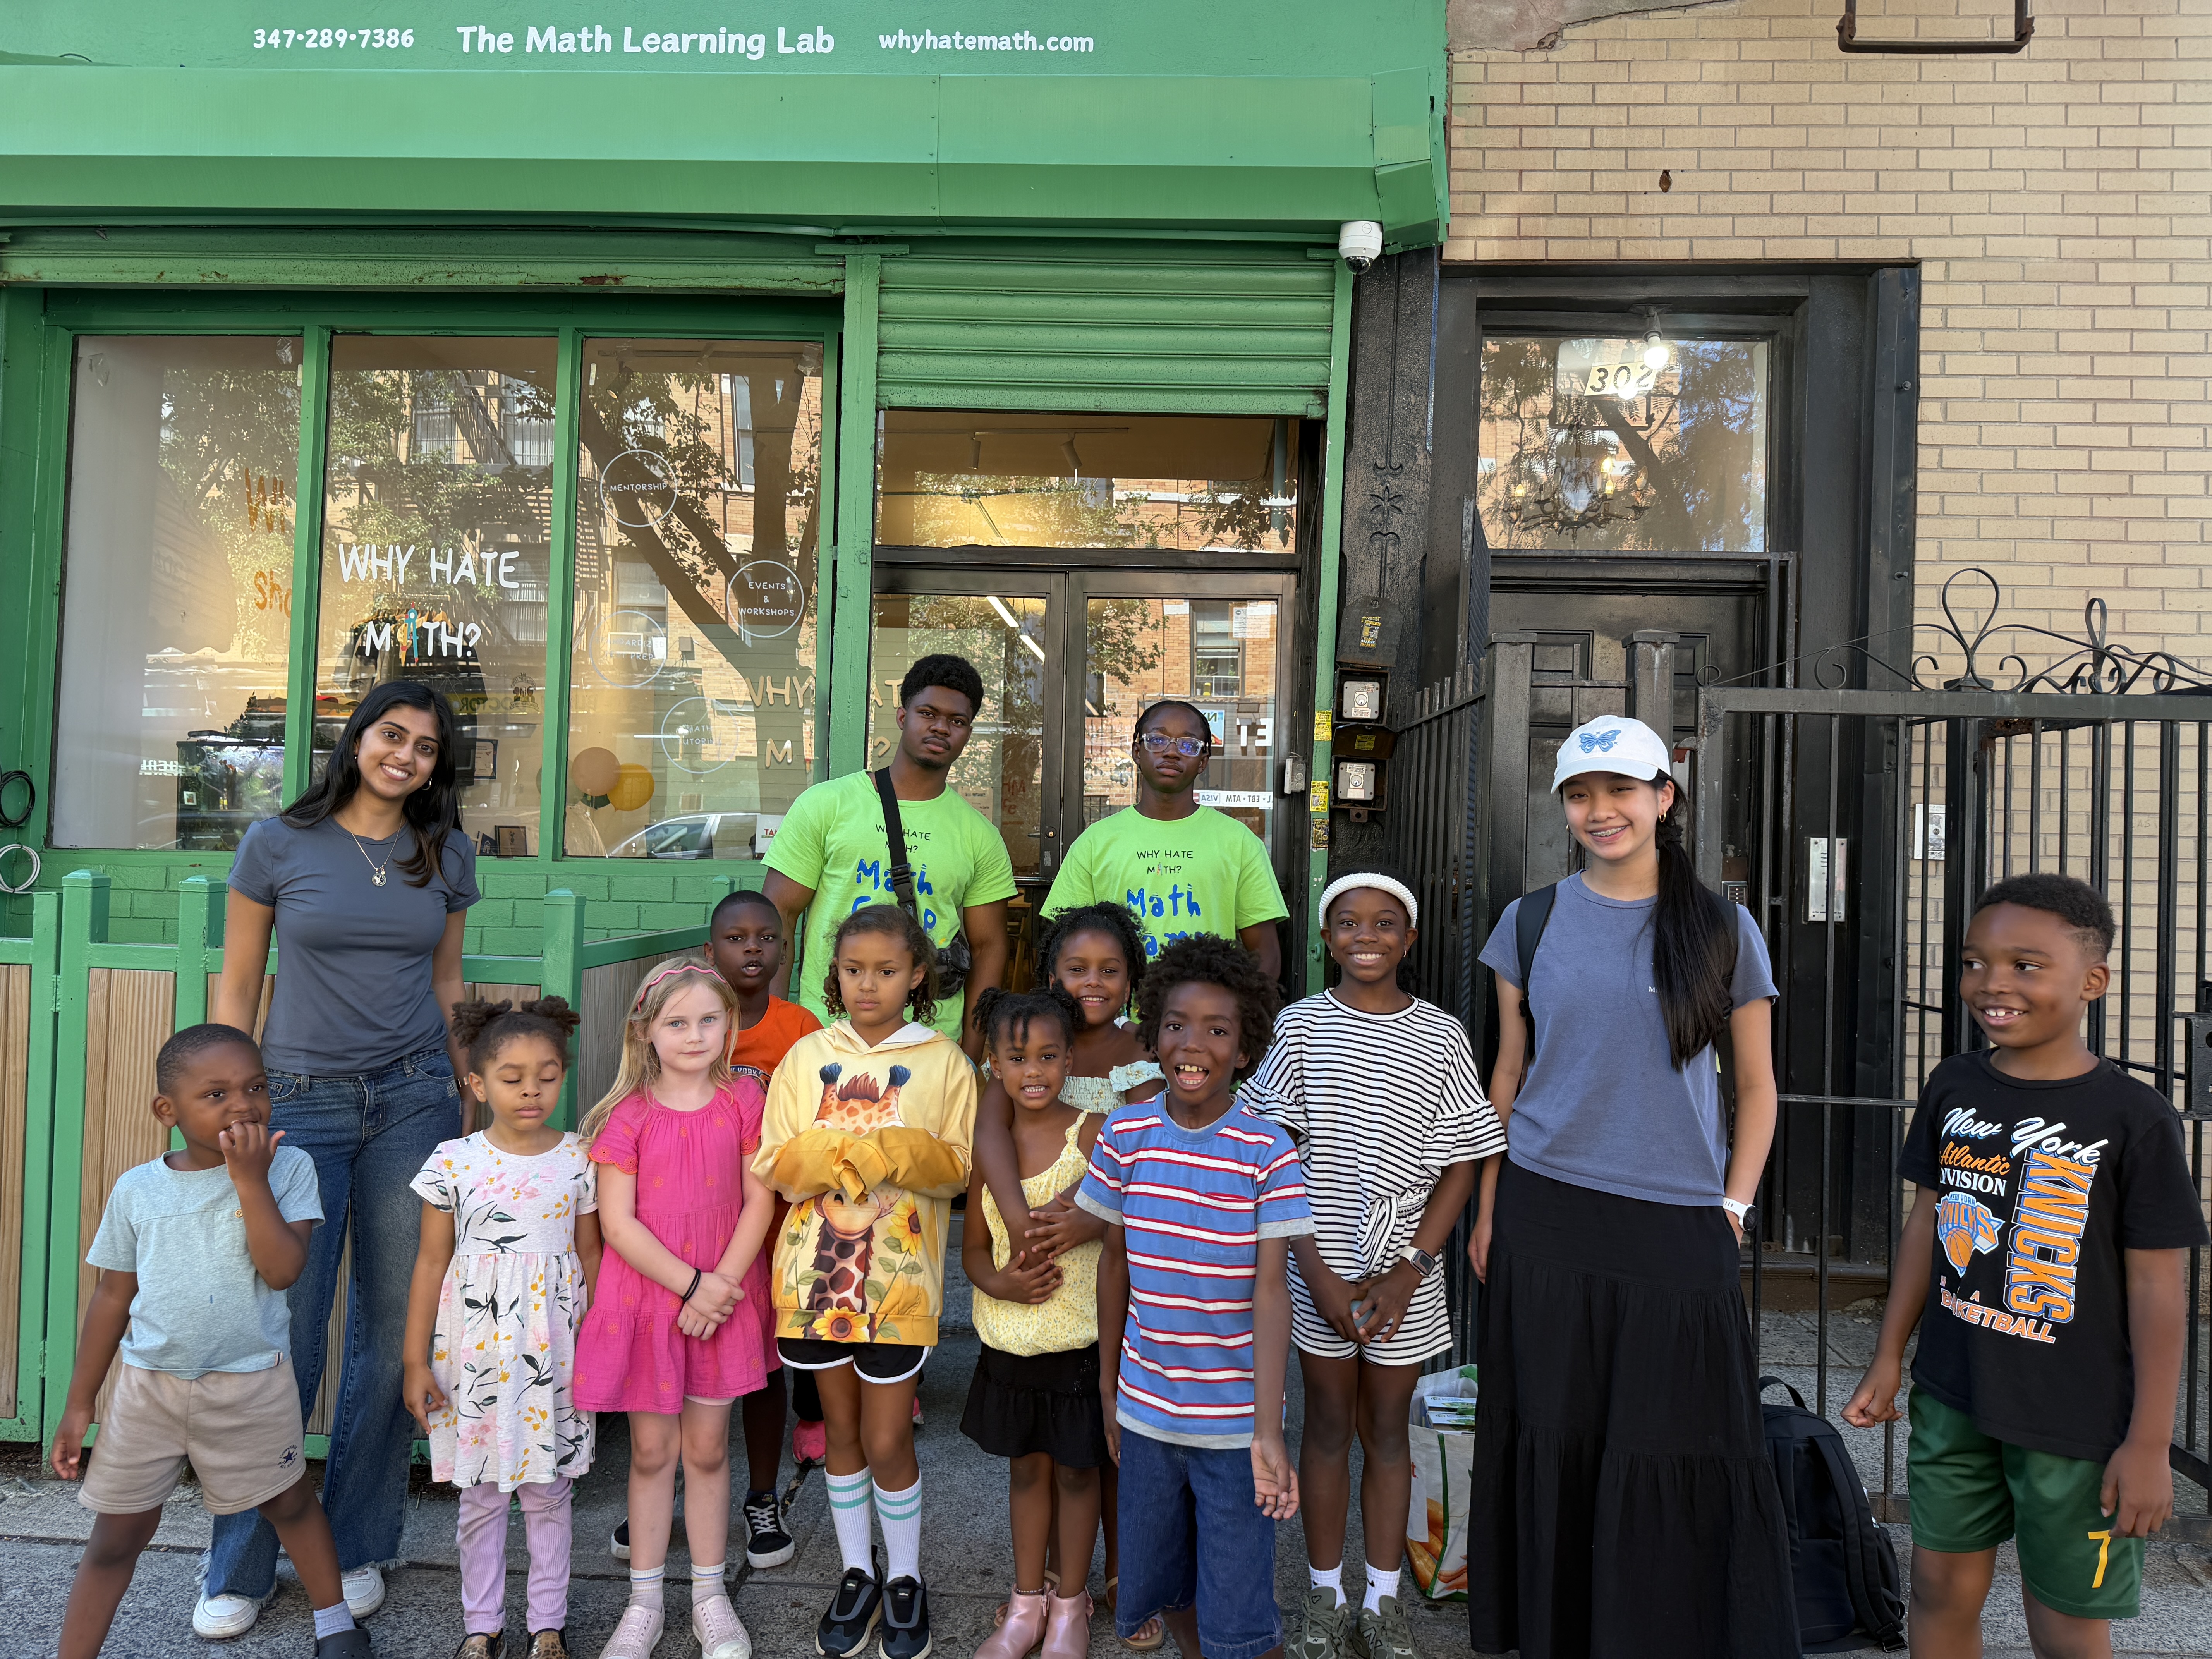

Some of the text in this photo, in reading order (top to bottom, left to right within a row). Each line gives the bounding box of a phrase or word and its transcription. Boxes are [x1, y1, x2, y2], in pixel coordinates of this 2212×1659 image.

[457, 25, 834, 60] The Math Learning Lab
[879, 29, 1094, 53] whyhatemath.com
[1590, 364, 1654, 393] 302
[610, 483, 668, 492] MENTORSHIP
[339, 543, 519, 588] WHY HATE
[748, 582, 785, 590] EVENTS
[738, 607, 795, 617] WORKSHOPS
[903, 829, 931, 841] HATE
[1137, 850, 1193, 859] WHY HATE
[856, 858, 933, 895] Mah
[1127, 883, 1201, 917] Math
[1941, 1107, 2109, 1166] New York
[1940, 1141, 2011, 1176] Atlantic
[1961, 1195, 1976, 1206] YORK
[1940, 1200, 1997, 1244] KNICKS
[2004, 1147, 2098, 1324] KNICKS
[2088, 1529, 2111, 1589] 7
